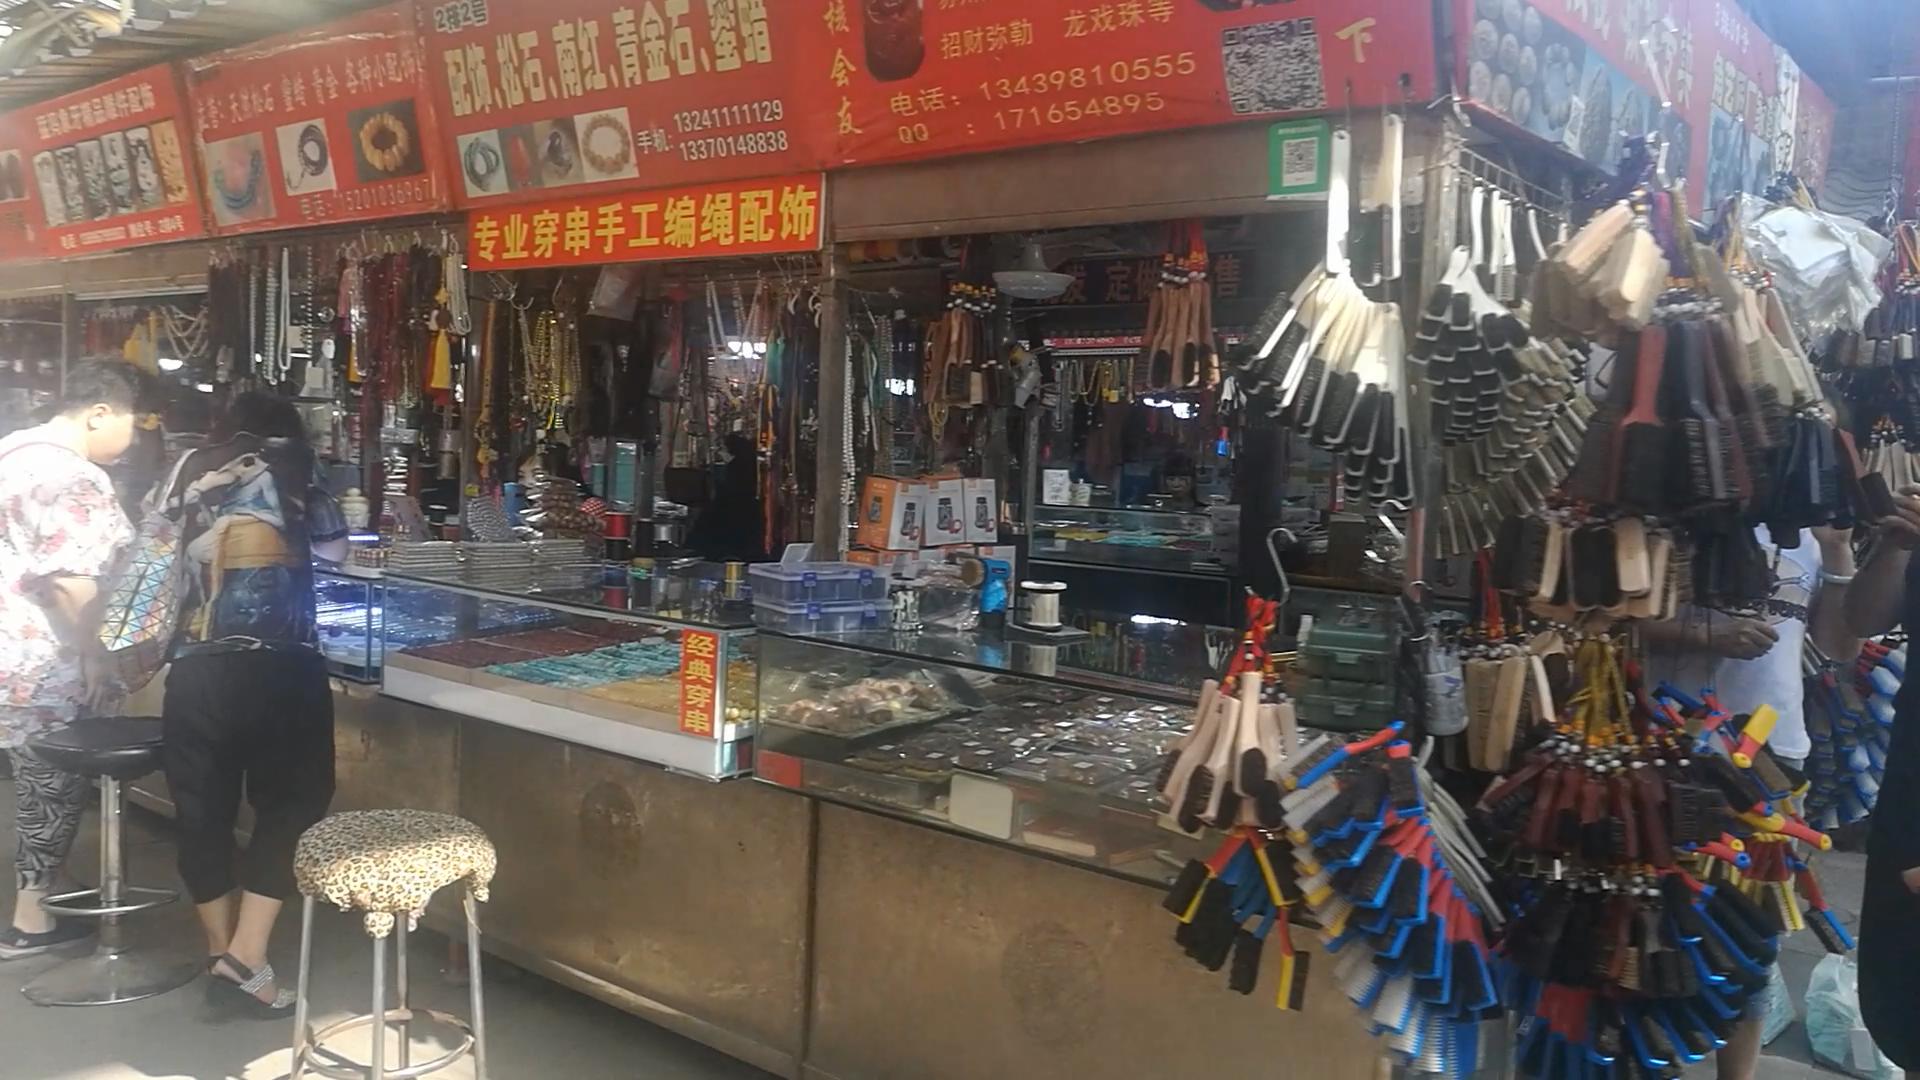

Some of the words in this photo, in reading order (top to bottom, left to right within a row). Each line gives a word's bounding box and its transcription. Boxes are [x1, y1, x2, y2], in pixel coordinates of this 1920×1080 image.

[940, 18, 1033, 60] 招财弥勒
[1063, 0, 1175, 38] 龙戏珠等
[979, 51, 1196, 102] 13439810555
[673, 99, 784, 134] 13241111129
[993, 91, 1165, 132] 171654895
[680, 130, 788, 162] 13370148838
[473, 184, 816, 262] 专业穿串手工编绳配饰
[684, 634, 715, 732] 经典穿串
